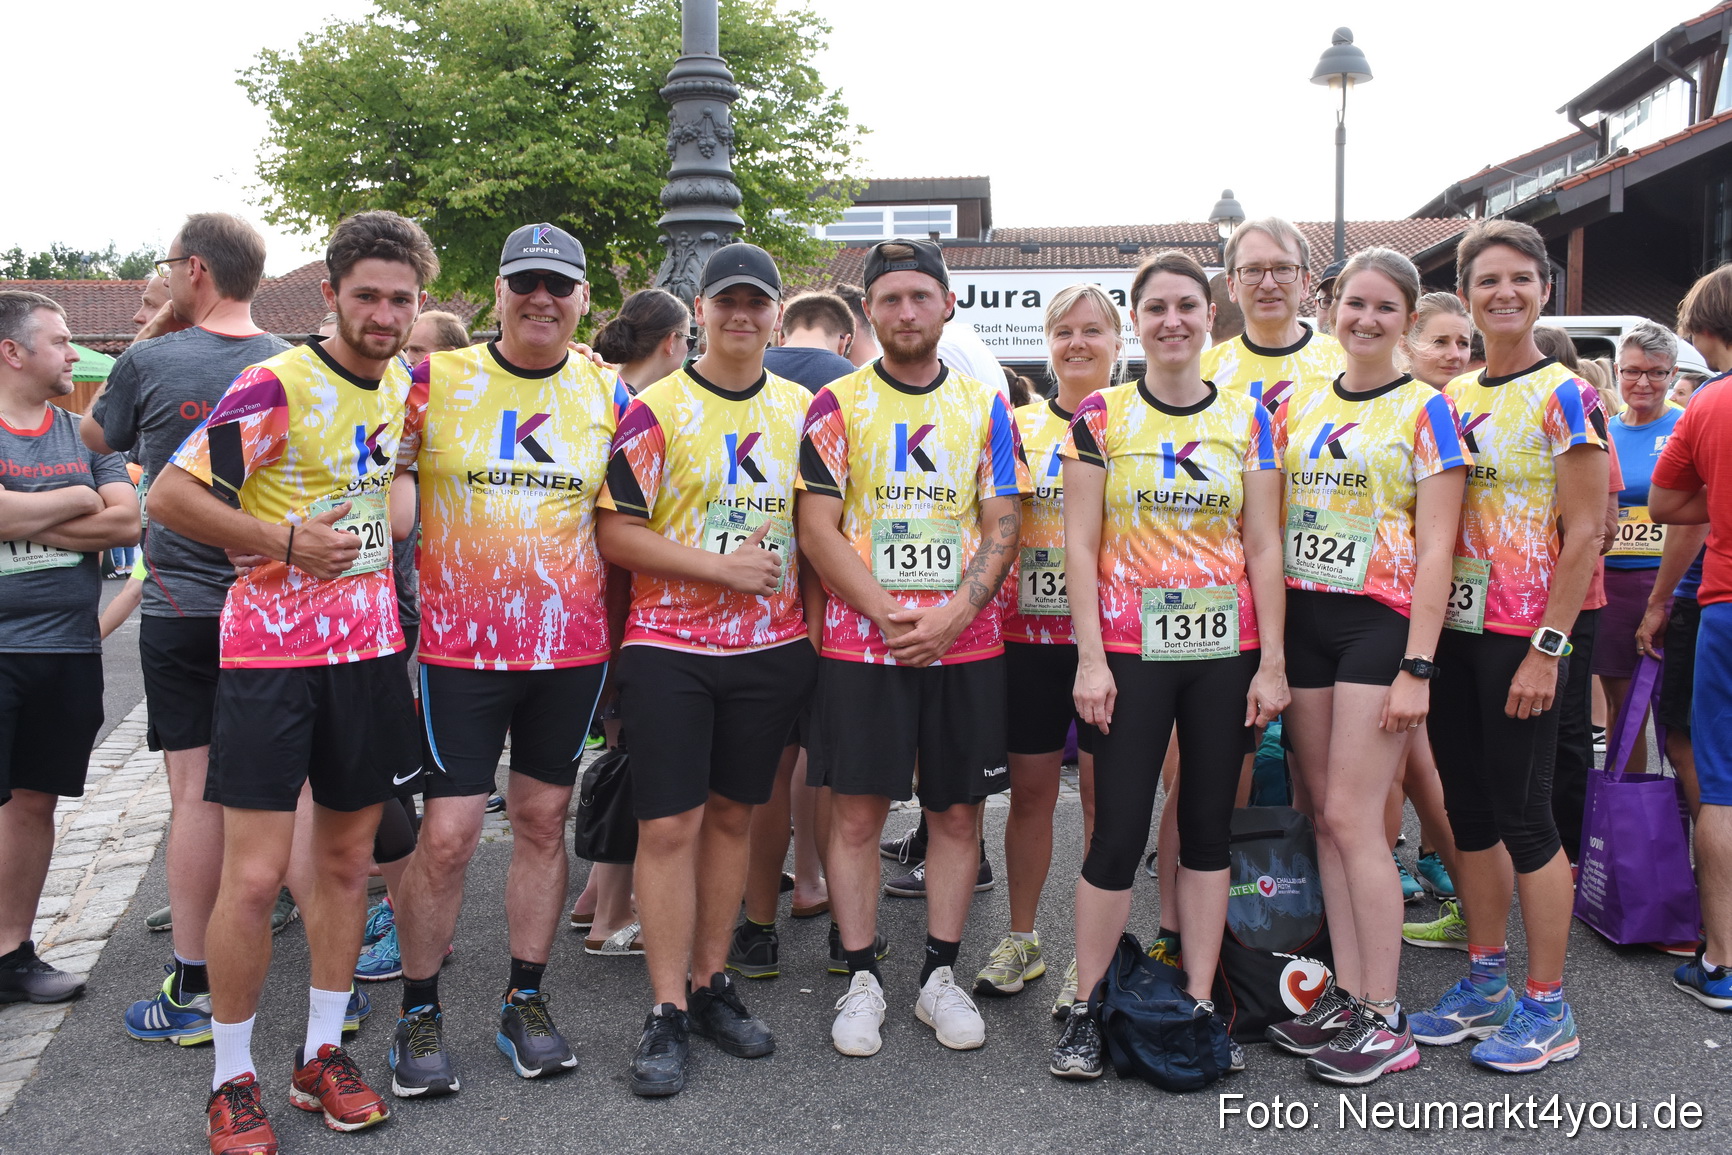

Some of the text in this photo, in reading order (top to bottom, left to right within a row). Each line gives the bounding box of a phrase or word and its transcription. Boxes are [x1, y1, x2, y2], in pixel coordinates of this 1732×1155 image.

[522, 246, 560, 255] KÜFNER
[957, 285, 1041, 309] Jura
[973, 323, 1002, 333] Stadt
[1012, 335, 1043, 346] Ihnen
[244, 402, 261, 410] Team
[0, 457, 91, 479] Oberbank
[467, 470, 584, 492] KÜFNER
[1291, 472, 1368, 488] KÜFNER
[469, 487, 499, 496] HOCH-
[501, 489, 520, 497] UND
[522, 489, 555, 498] TIEFBAU
[875, 485, 957, 504] KÜFNER
[1291, 487, 1306, 495] OCH-
[1347, 490, 1368, 498] GMBH
[1137, 489, 1231, 508] KÜFNER
[876, 502, 894, 510] OCH-
[1296, 519, 1329, 531] firmenlauf
[885, 532, 923, 540] firmenlauf
[1348, 534, 1367, 543] 2019
[362, 549, 382, 559] Sascha
[1293, 531, 1356, 568] 1324
[12, 551, 69, 563] Granzow Jochen
[883, 544, 952, 570] 1319
[1295, 558, 1344, 574] Schulz Viktoria
[1319, 570, 1337, 579] Tiefbau
[1337, 574, 1355, 582] GmbH
[1465, 577, 1483, 586] 2019
[1034, 596, 1057, 604] Küfner
[1157, 601, 1197, 610] firmenlauf
[1217, 603, 1233, 612] 2019
[1155, 612, 1227, 641] 1318
[1182, 640, 1220, 648] Christiane
